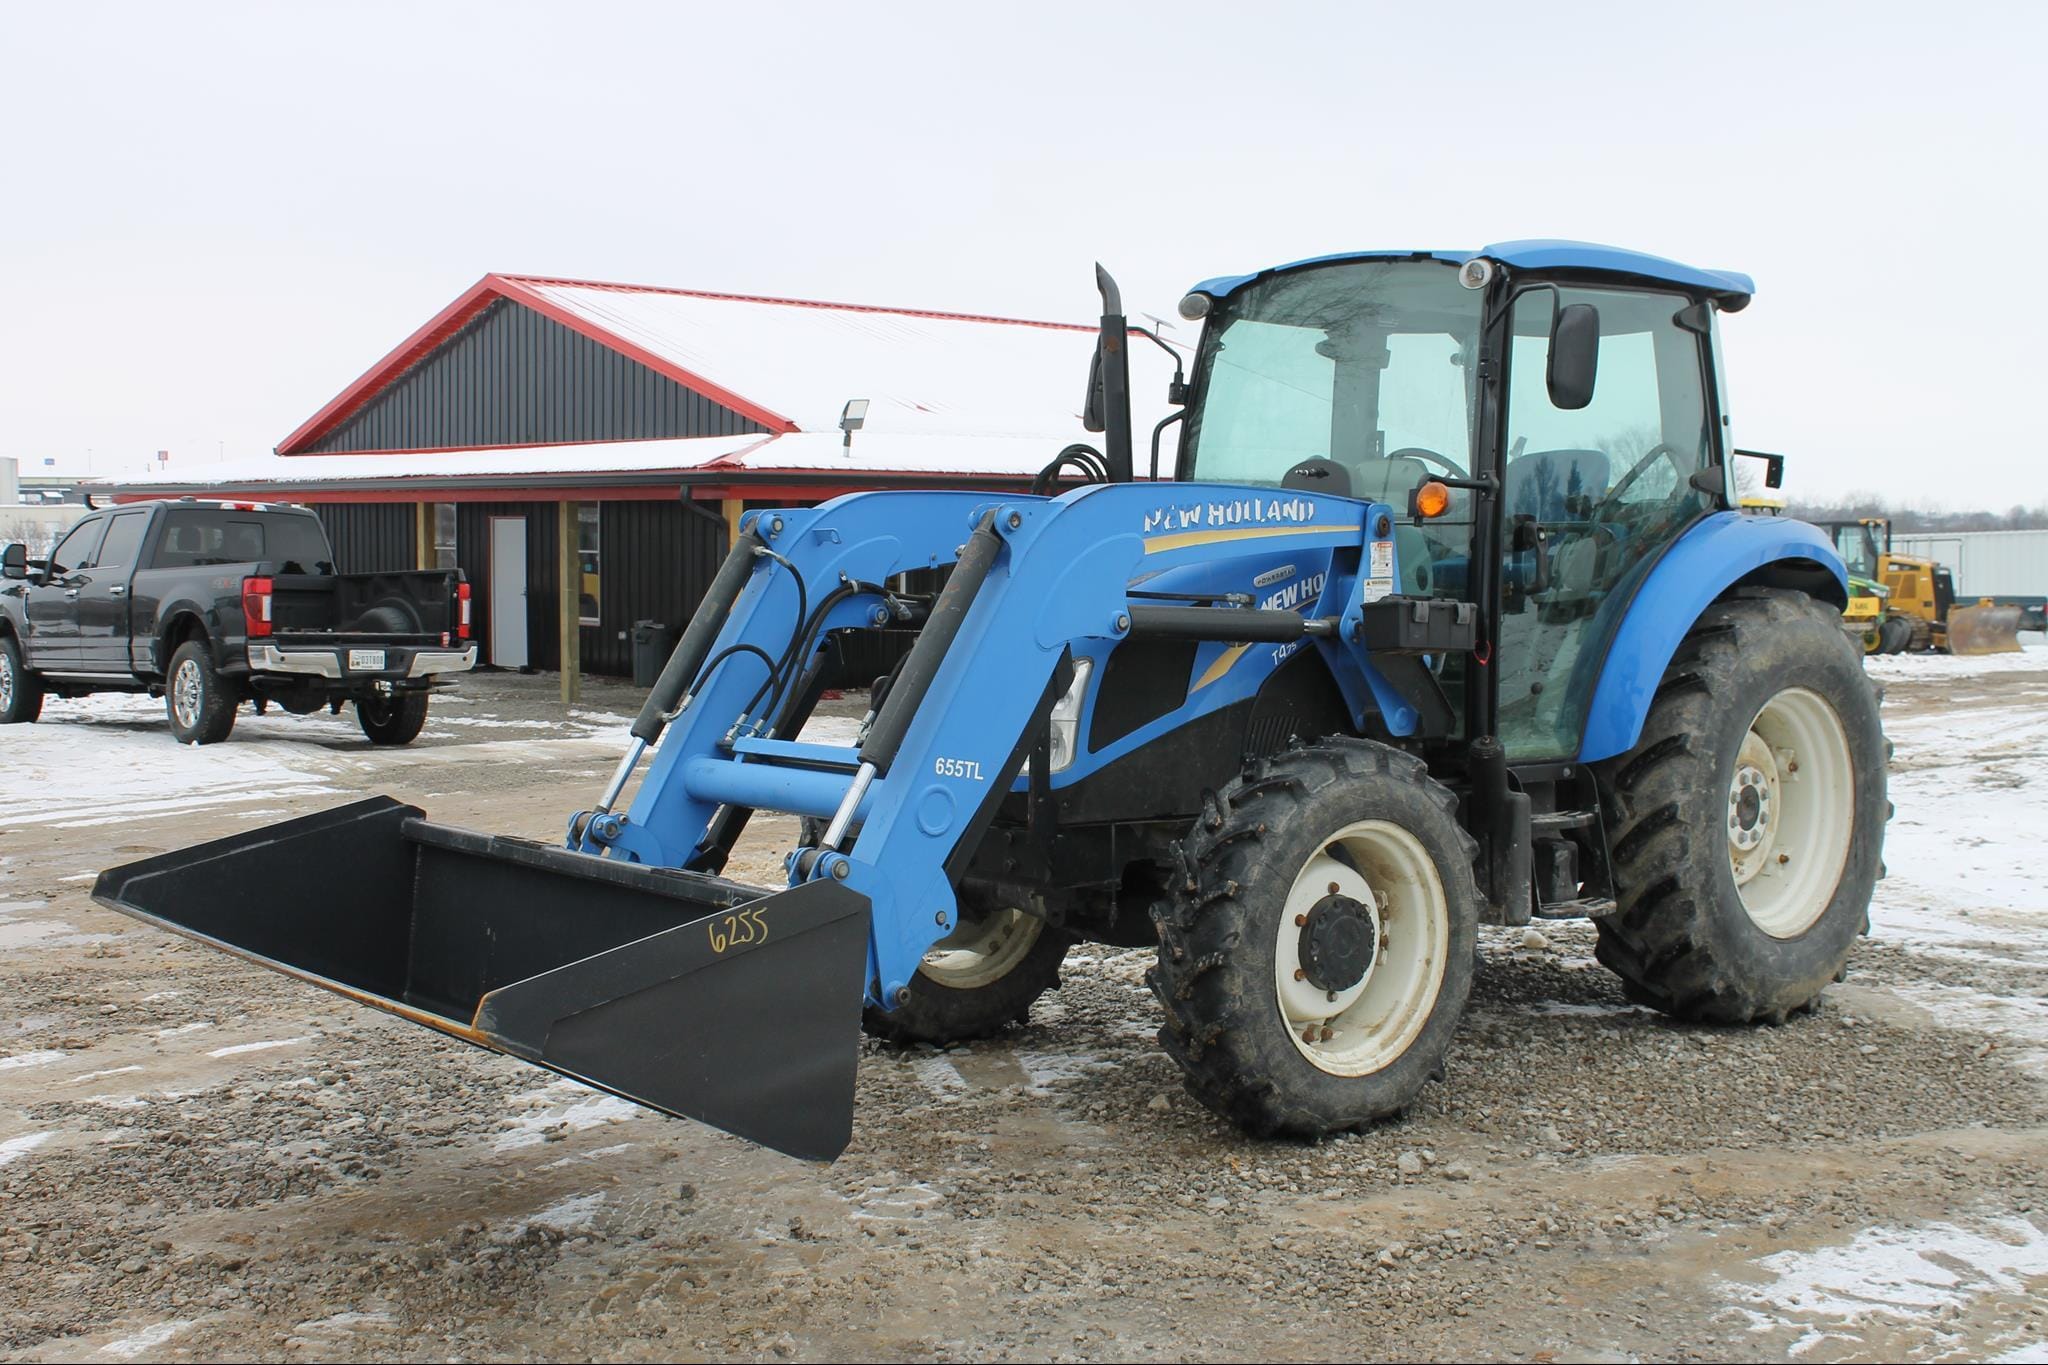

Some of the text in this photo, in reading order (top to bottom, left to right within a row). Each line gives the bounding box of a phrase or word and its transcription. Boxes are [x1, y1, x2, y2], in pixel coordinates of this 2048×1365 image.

[1207, 497, 1315, 526] HOLLAND
[1260, 571, 1328, 610] NEW HO
[935, 757, 984, 780] 655TL
[708, 906, 768, 953] 6255
